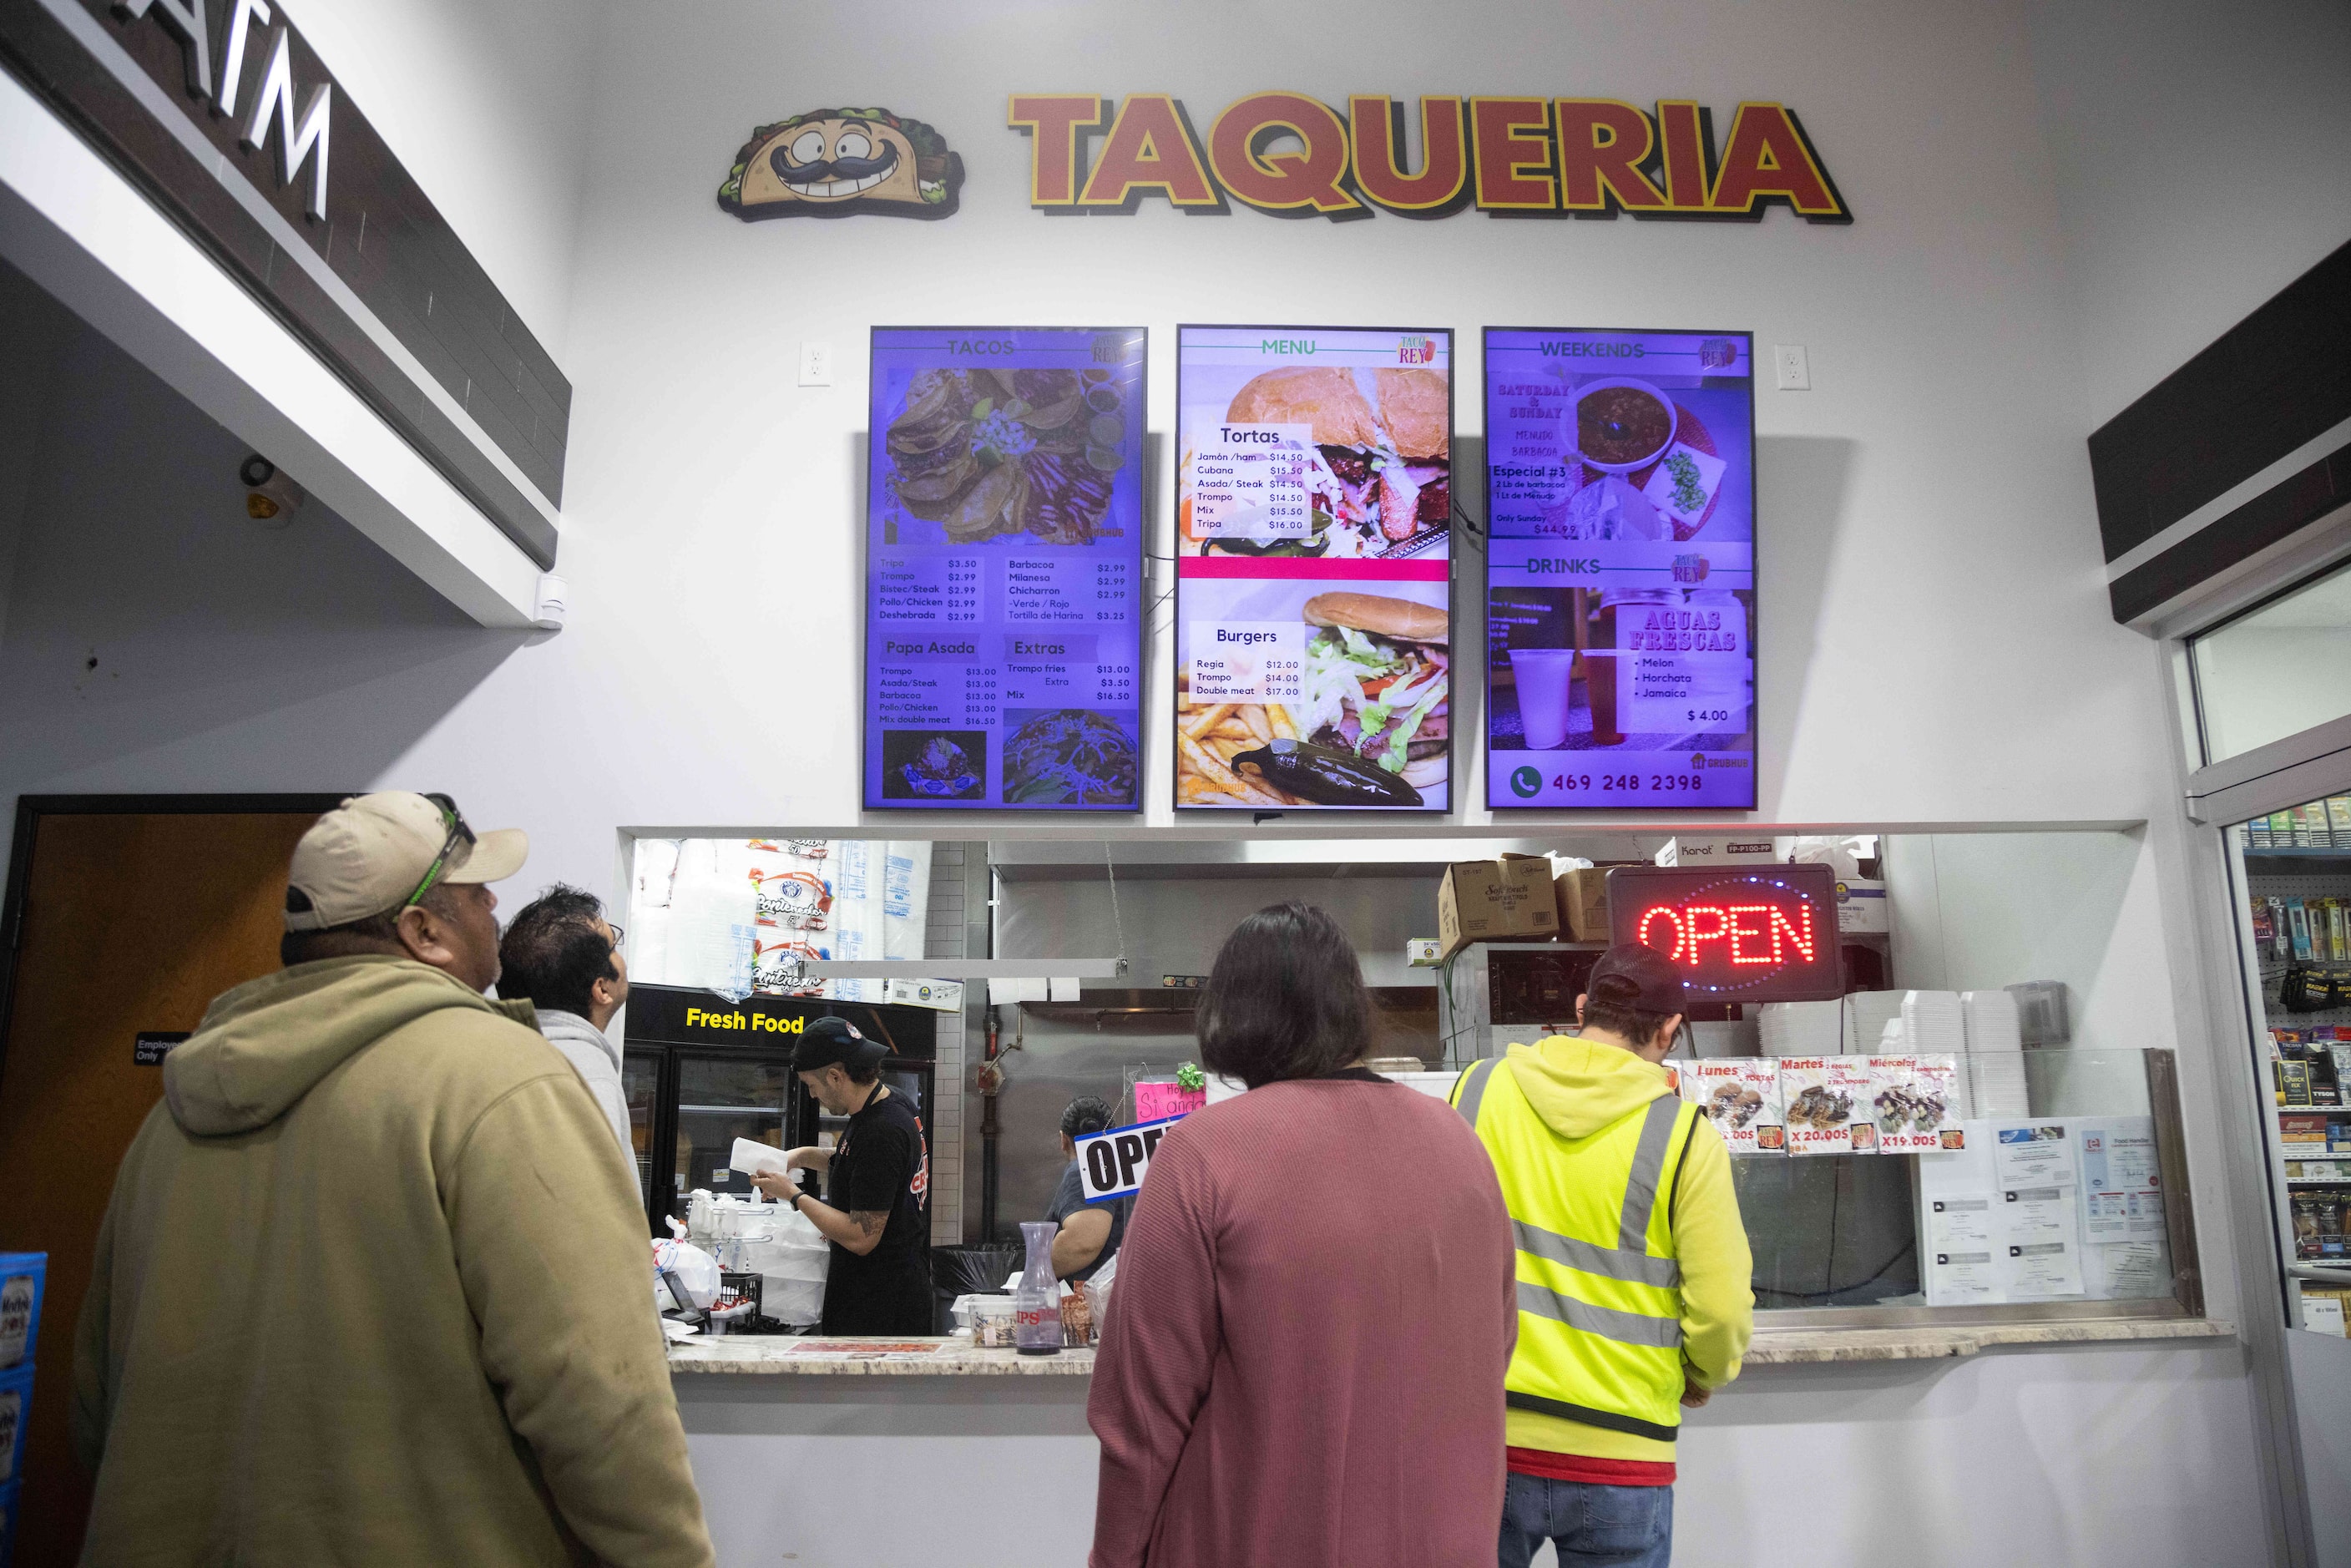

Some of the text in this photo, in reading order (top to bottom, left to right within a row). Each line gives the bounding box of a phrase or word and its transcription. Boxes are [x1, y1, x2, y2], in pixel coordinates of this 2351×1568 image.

[1007, 91, 1848, 220] TAQUERIA
[1401, 336, 1425, 347] TACO
[948, 340, 1014, 355] TACOS
[1262, 340, 1316, 355] MENU
[1540, 341, 1646, 358] WEEKENDS
[1399, 347, 1428, 364] REY
[1499, 385, 1570, 397] SATURDAY
[1529, 397, 1539, 407] &
[1509, 408, 1562, 419] SUNDAY
[1221, 428, 1280, 443] Tortas
[1516, 431, 1553, 441] MENUDO
[1197, 453, 1302, 462] Jamón /ham $14.50
[1512, 448, 1558, 457] BARBACOA
[1197, 467, 1302, 475] Cubana $15.50
[1494, 466, 1566, 478] Especial #3
[1198, 479, 1302, 488] Asada/ Steak $14.50
[1197, 493, 1302, 502] Trompo $14.50
[1270, 507, 1302, 516] $15.50
[1496, 514, 1547, 523] Only Sunday
[1197, 520, 1302, 529] Tripa $16.00
[1534, 525, 1576, 534] $44.99
[881, 559, 976, 569] Tripa $3.50
[1009, 560, 1125, 573] Barbacoa $2.99
[1527, 559, 1600, 574] DRINKS
[880, 572, 976, 581] Trompo $2.99
[1674, 566, 1701, 582] REY
[1009, 574, 1125, 586] Milanesa $2.99
[880, 584, 975, 594] Bistec/Steak $2.99
[1009, 586, 1125, 599] Chicharron $2.99
[880, 598, 975, 608] Pollo/Chicken $2.99
[1050, 599, 1069, 609] Rojo
[880, 611, 975, 621] Deshebrada $2.99
[1009, 611, 1125, 620] Tortilla de Harina $3.25
[1645, 611, 1721, 630] AGUAS
[1217, 630, 1277, 645] Burgers
[1630, 631, 1736, 651] FRESCAS
[887, 641, 975, 655] Papa Asada
[1014, 641, 1065, 655] Extras
[1197, 660, 1298, 670] Regia $12.00
[1642, 659, 1674, 667] Melon
[880, 668, 996, 676] Trompo $13.00
[1008, 665, 1130, 674] Trompo fries $13.00
[1101, 679, 1130, 687] $3.50
[1197, 674, 1298, 683] Trompo $14.00
[1642, 674, 1691, 682] Horchata
[880, 680, 996, 689] Asada/Steak $13.00
[880, 691, 921, 700] Barbacoa
[1007, 690, 1130, 701] Mix $16.50
[1196, 686, 1228, 695] Double
[1266, 687, 1298, 695] $17.00
[1642, 689, 1686, 698] Jamaica
[880, 704, 996, 713] Pollo/Chicken $13.00
[880, 716, 895, 724] Mix
[897, 716, 926, 724] double
[965, 717, 996, 726] $16.50
[1687, 711, 1728, 721] $ 4.00
[1707, 758, 1748, 768] GRUBHUB
[1553, 775, 1702, 791] 469 248 2398
[1681, 844, 1771, 856] Karat FP-P100-PP
[1639, 903, 1815, 966] OPEN
[686, 1008, 805, 1034] Fresh Food
[137, 1051, 158, 1062] Only
[1782, 1060, 1823, 1070] Martes
[1697, 1065, 1738, 1076] Lunes
[1167, 1084, 1184, 1098] Hoy
[1140, 1092, 1159, 1119] Si
[1792, 1130, 1848, 1141] X 20.00$
[1760, 1136, 1777, 1146] REY
[1882, 1136, 1936, 1146] X19.00$
[1086, 1127, 1172, 1191] OP
